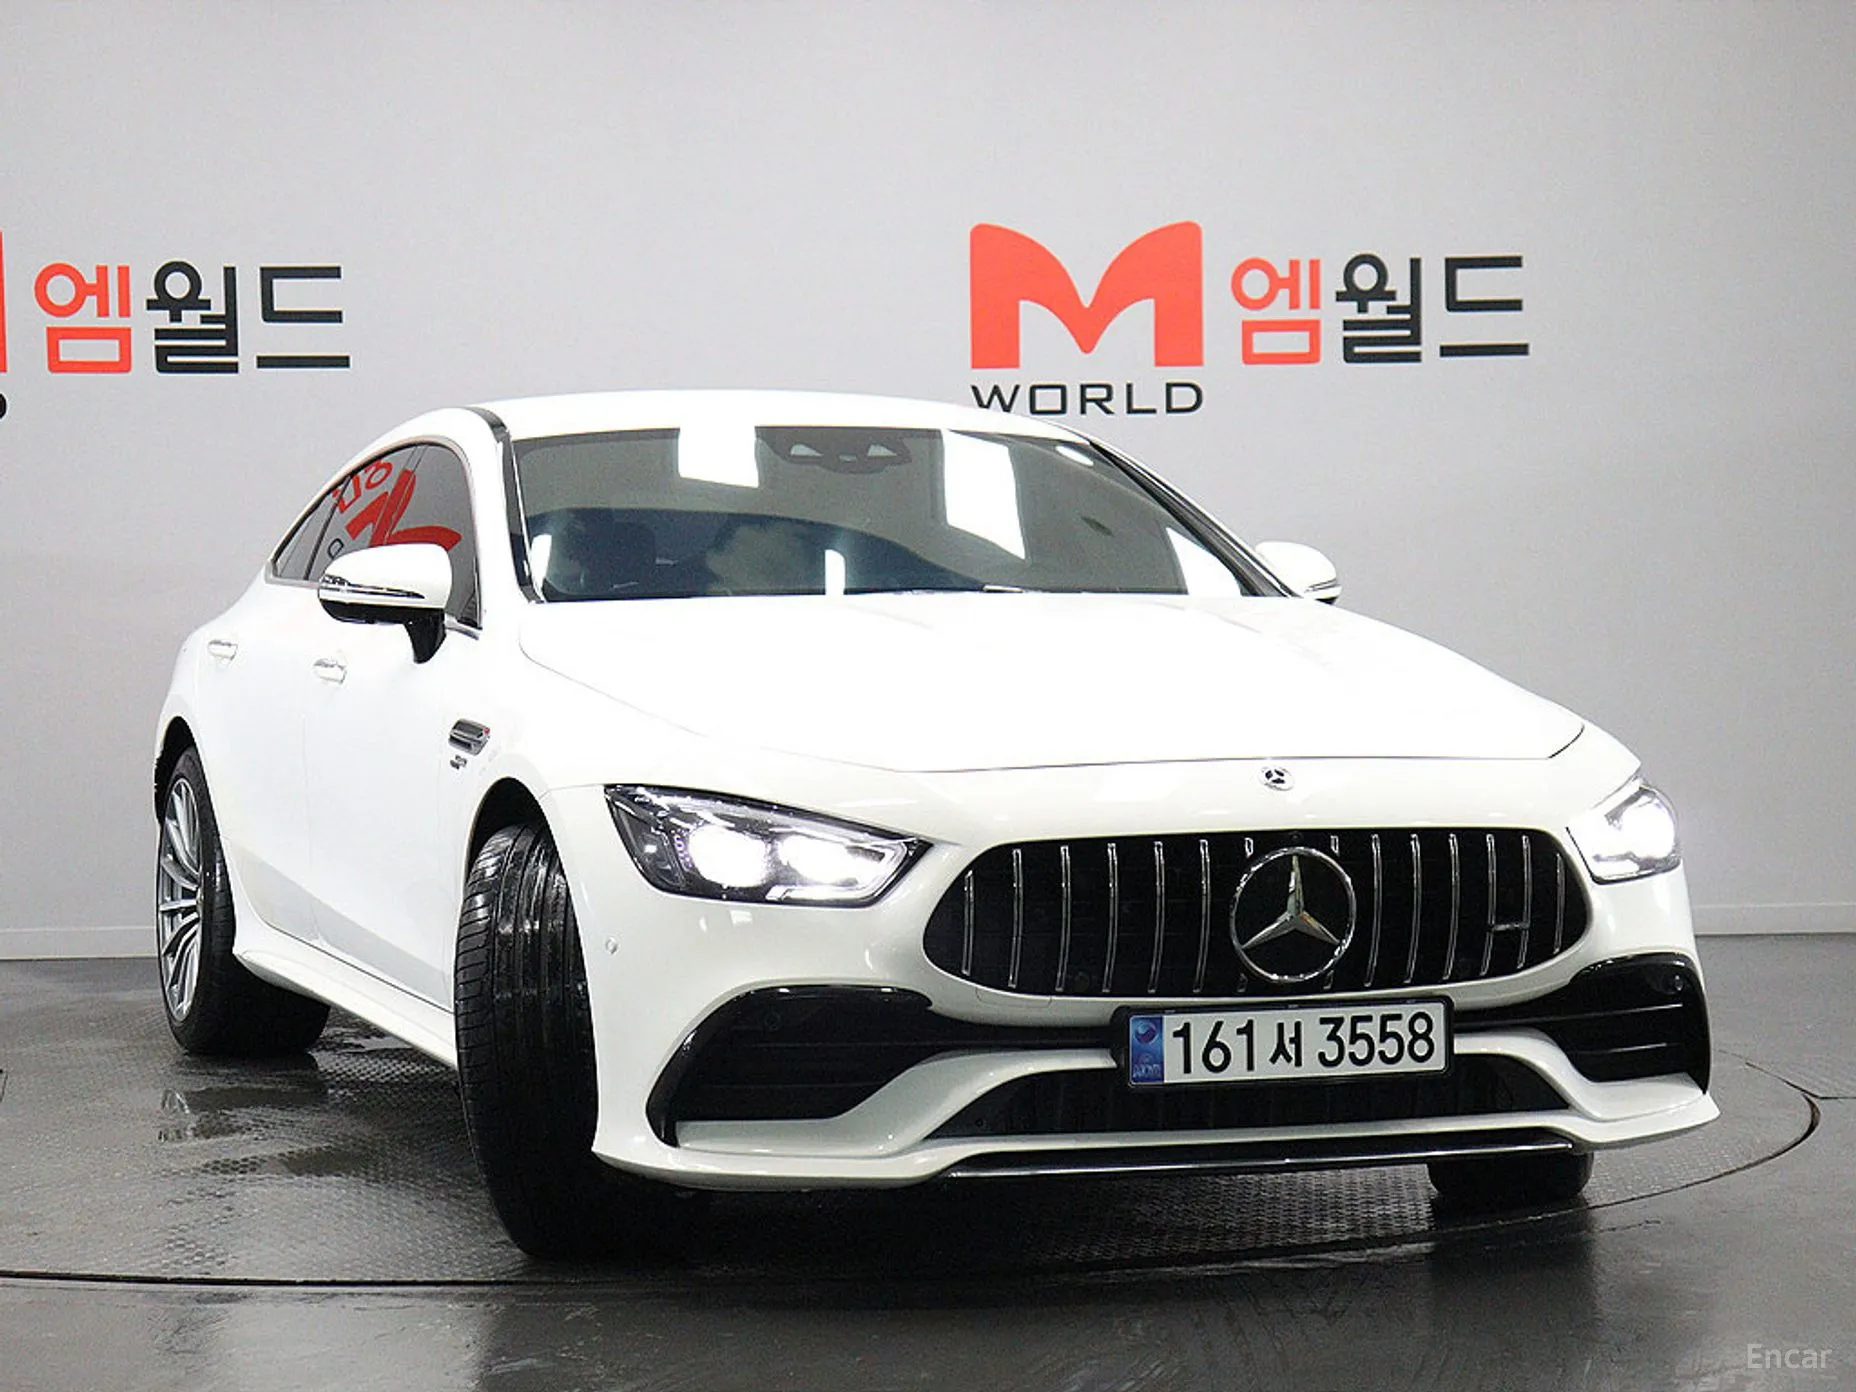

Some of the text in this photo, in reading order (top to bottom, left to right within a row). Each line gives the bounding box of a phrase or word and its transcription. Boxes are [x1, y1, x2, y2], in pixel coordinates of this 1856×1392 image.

[35, 260, 351, 374] 엠월드
[970, 221, 1204, 369] M
[1231, 253, 1530, 365] 엠월드
[971, 382, 1204, 416] WORLD
[1318, 1011, 1436, 1068] 3558
